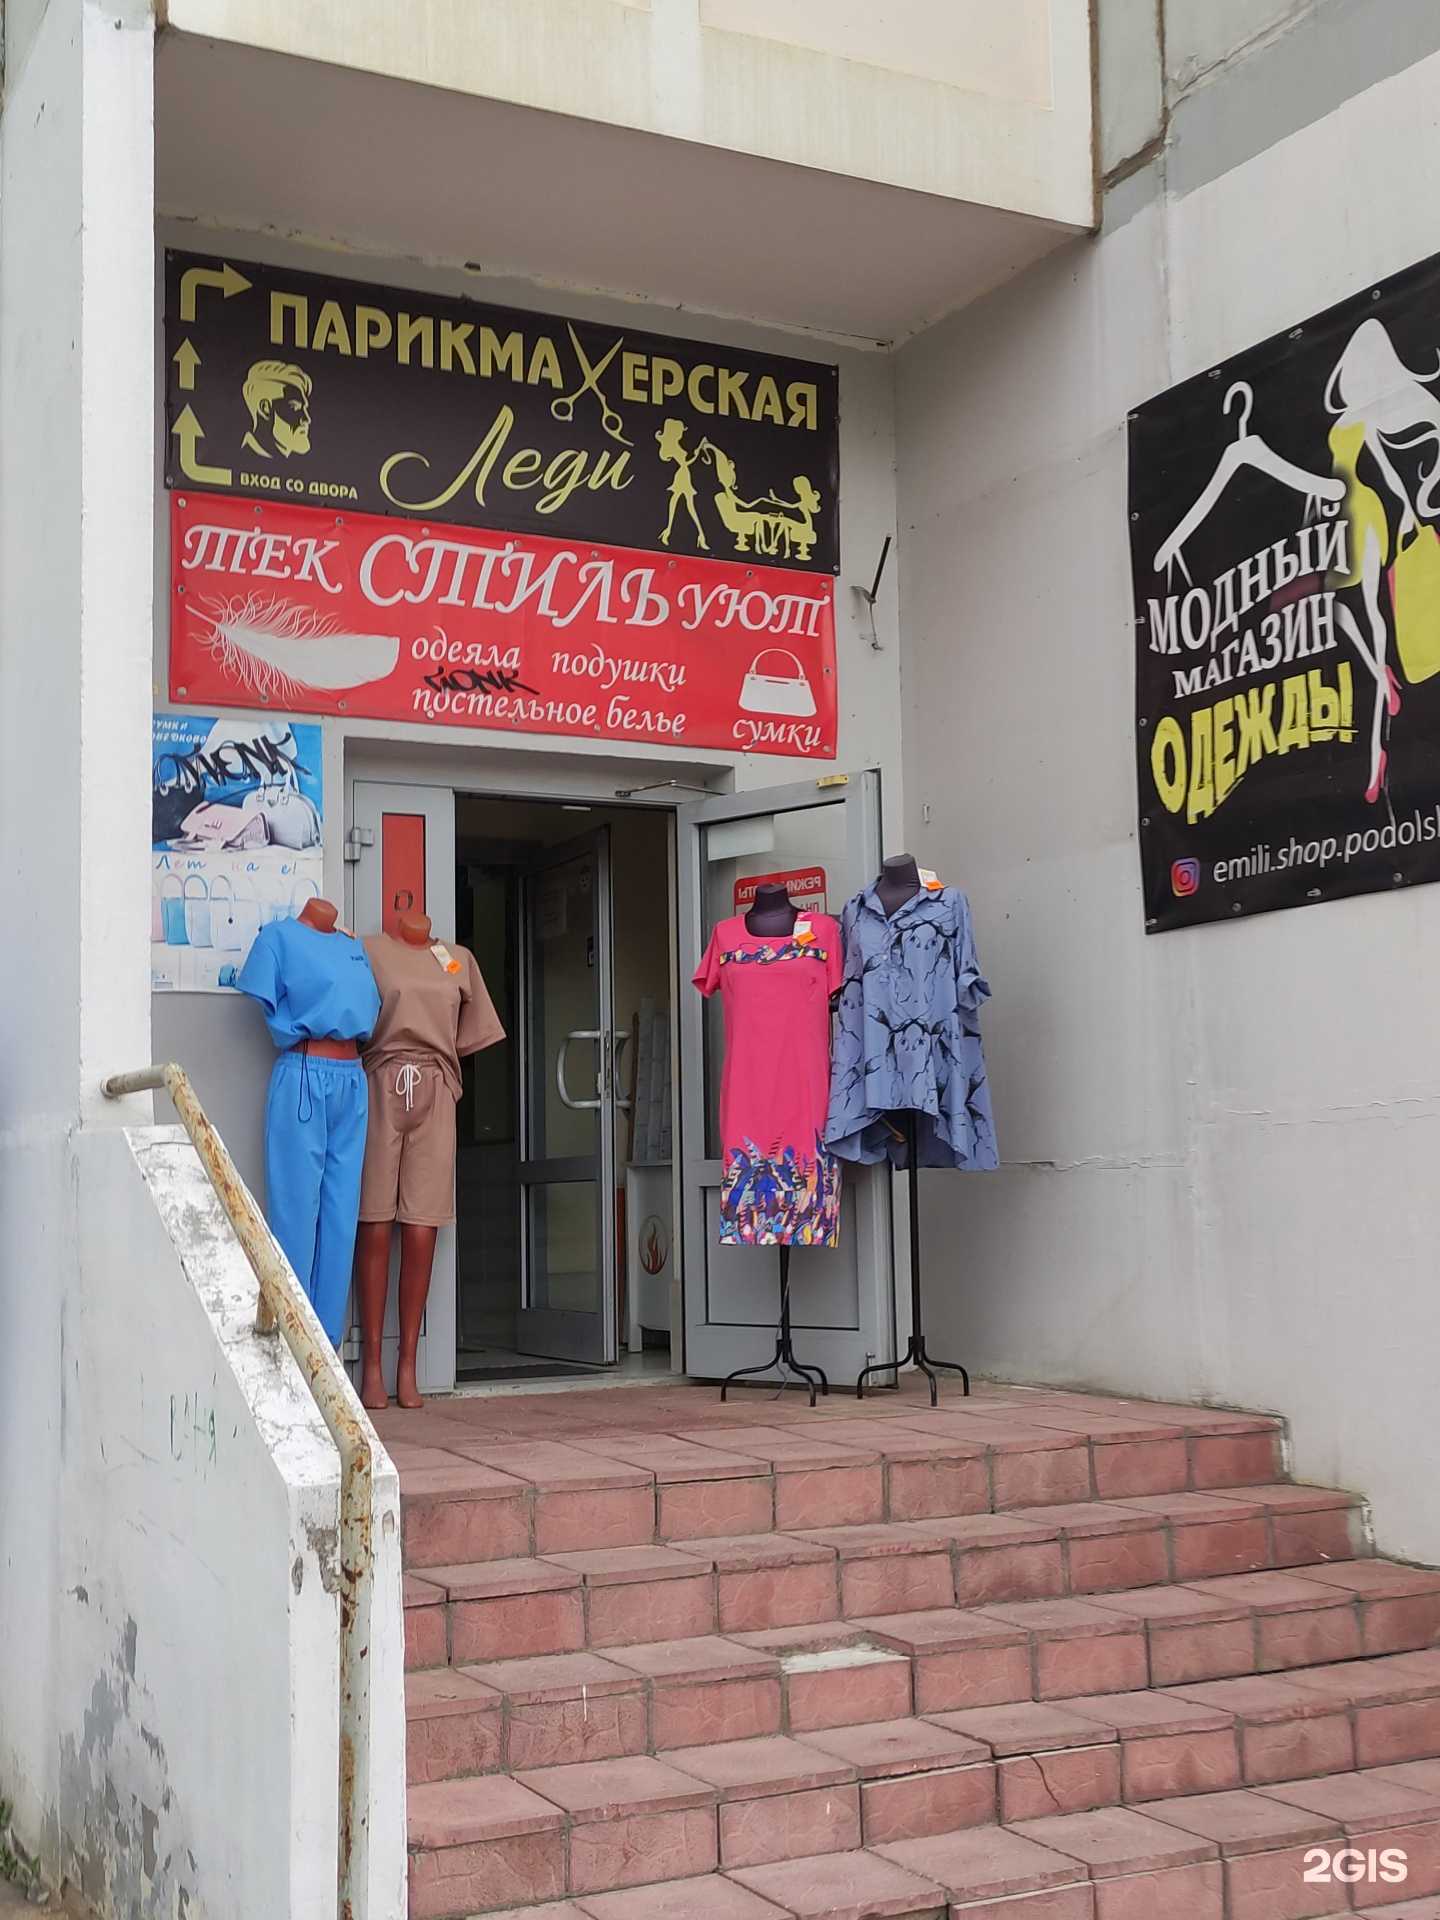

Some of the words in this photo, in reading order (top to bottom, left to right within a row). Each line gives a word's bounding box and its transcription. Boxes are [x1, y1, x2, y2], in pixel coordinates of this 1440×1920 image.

[240, 472, 281, 490] ВХОД
[285, 478, 304, 493] СО
[308, 481, 358, 500] ДВОРА
[378, 404, 637, 515] Леди
[676, 583, 832, 638] УЮТ
[1147, 502, 1351, 655] МОДНЫЙ
[411, 625, 521, 668] одеяла
[551, 642, 687, 693] подушки
[1172, 591, 1338, 699] МАГАЗИН
[411, 688, 597, 726] постельное
[606, 694, 687, 734] белье
[731, 716, 822, 751] сумки
[1151, 660, 1357, 825] ОДЕЖДЫ
